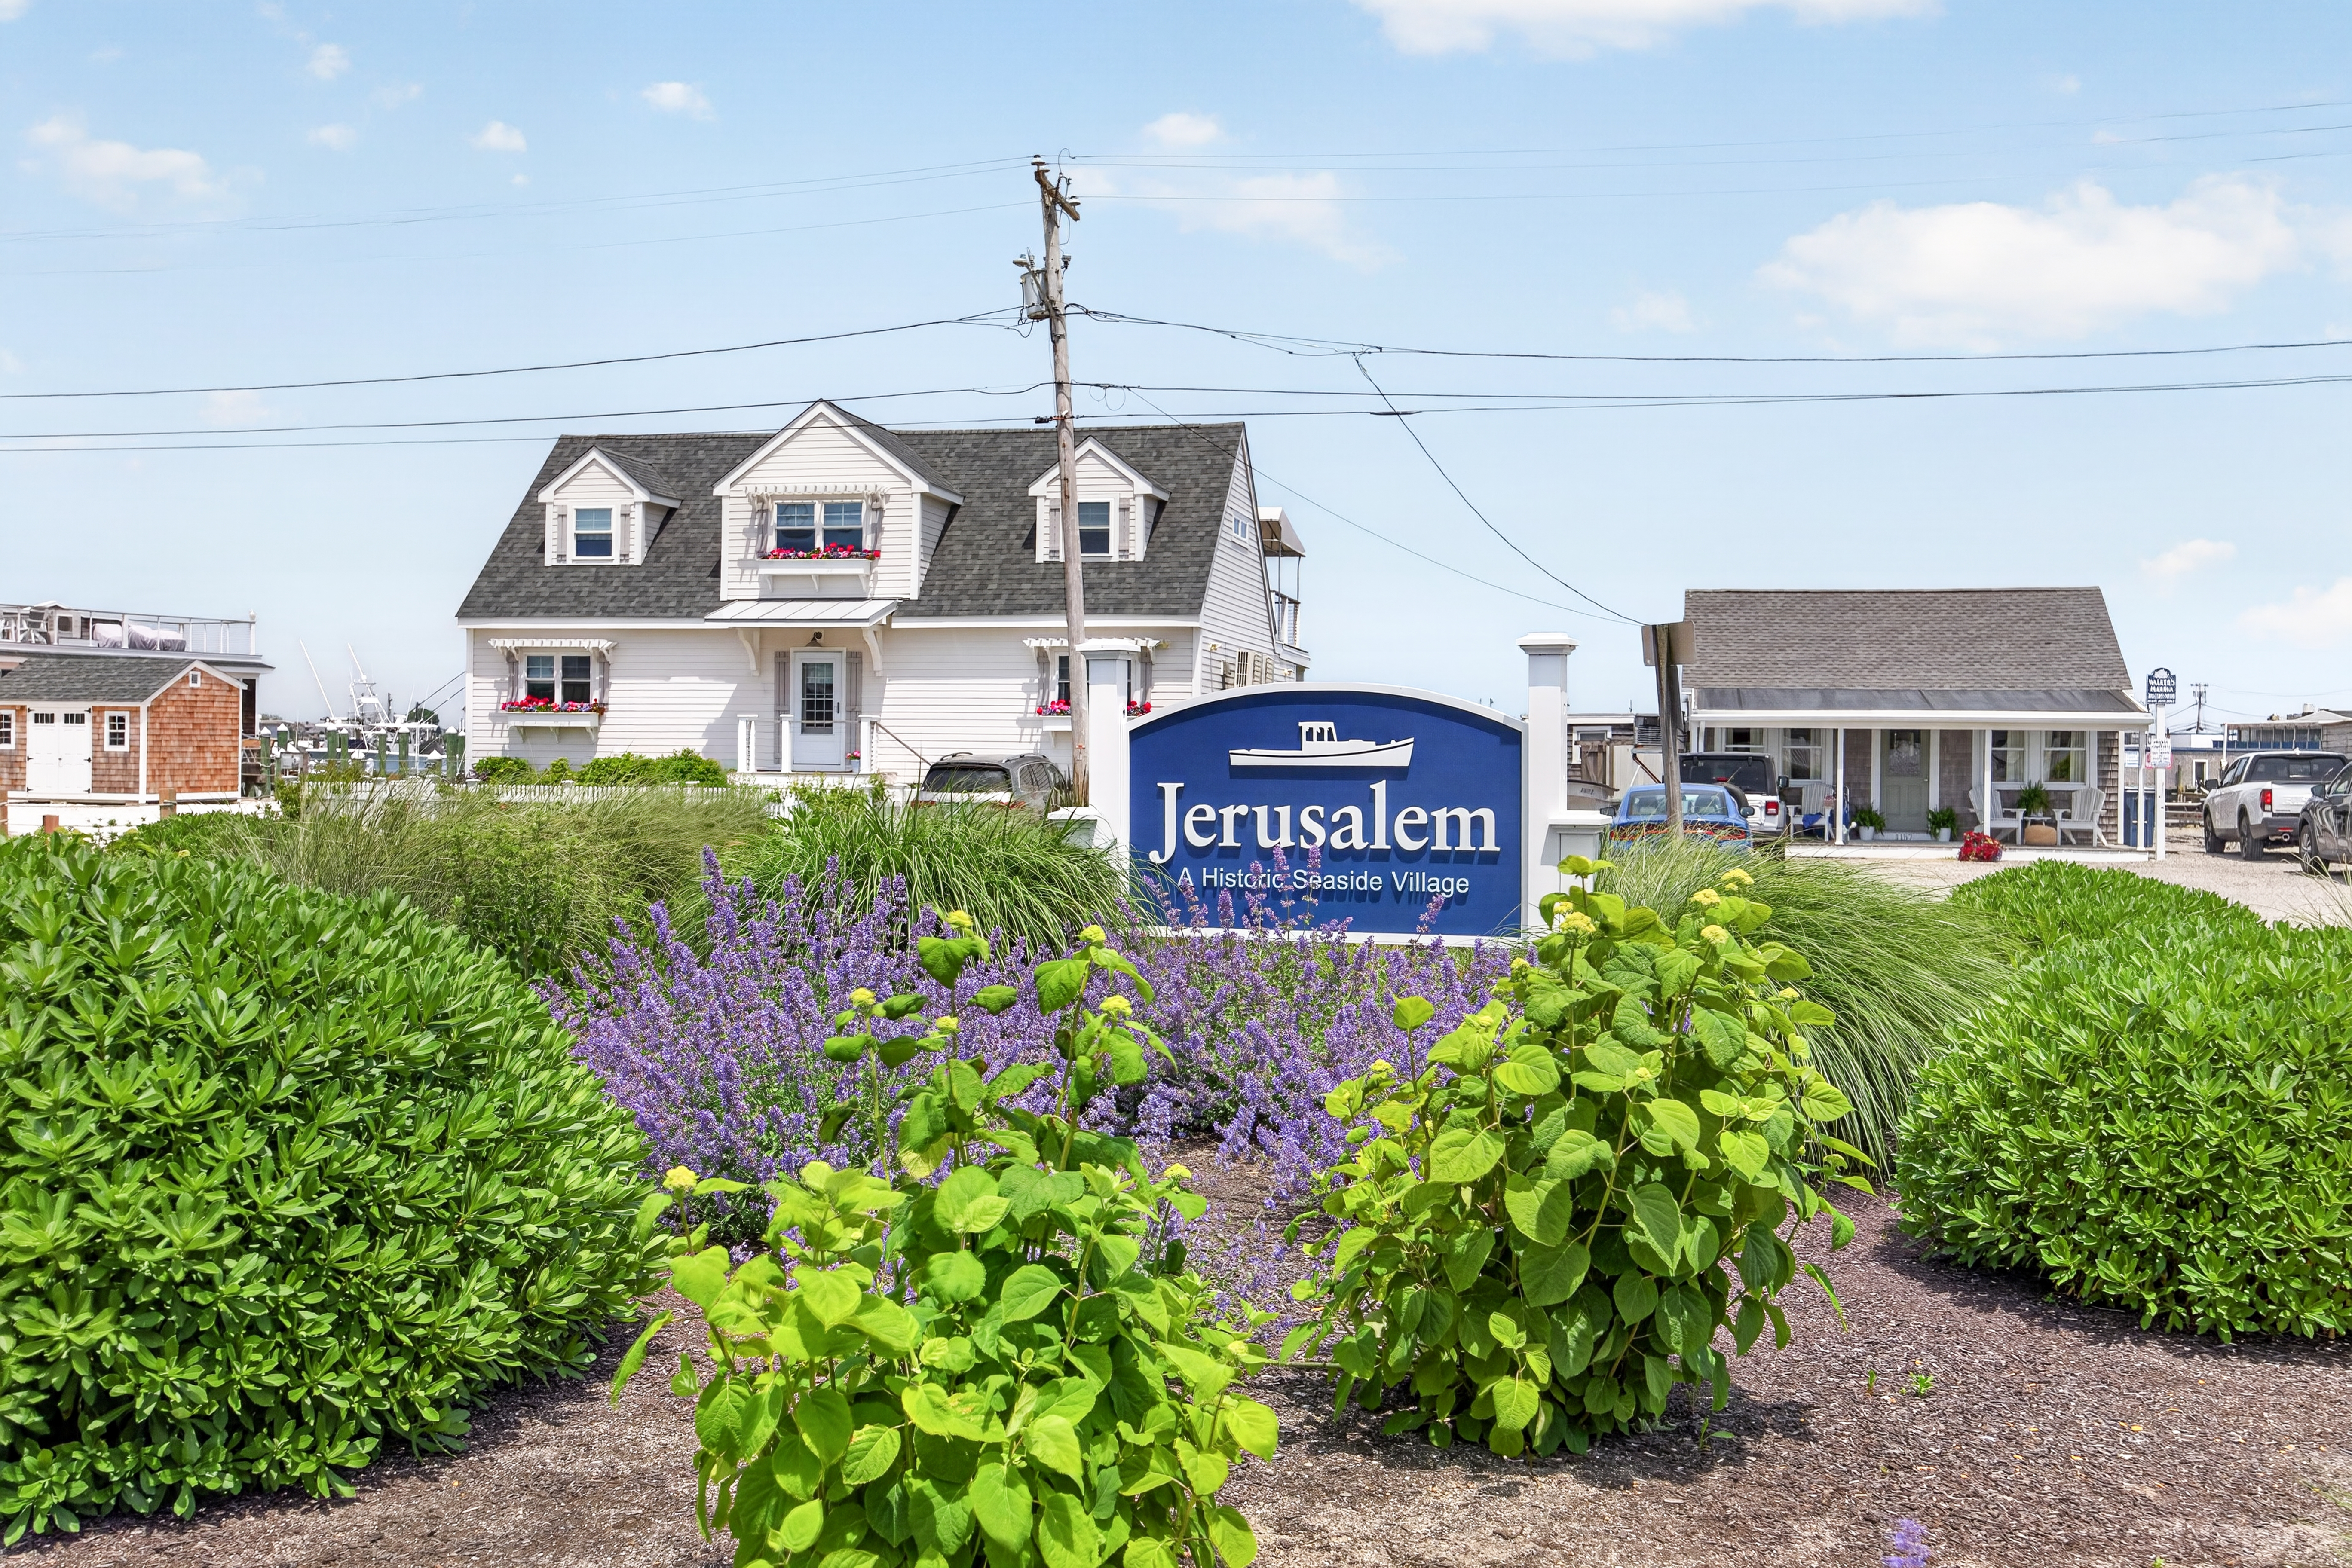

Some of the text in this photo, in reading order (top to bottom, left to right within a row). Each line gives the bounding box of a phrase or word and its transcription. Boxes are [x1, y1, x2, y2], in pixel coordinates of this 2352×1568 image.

[1149, 779, 1501, 864] Jerusalem
[1178, 867, 1469, 898] A Historic Seaside Village
